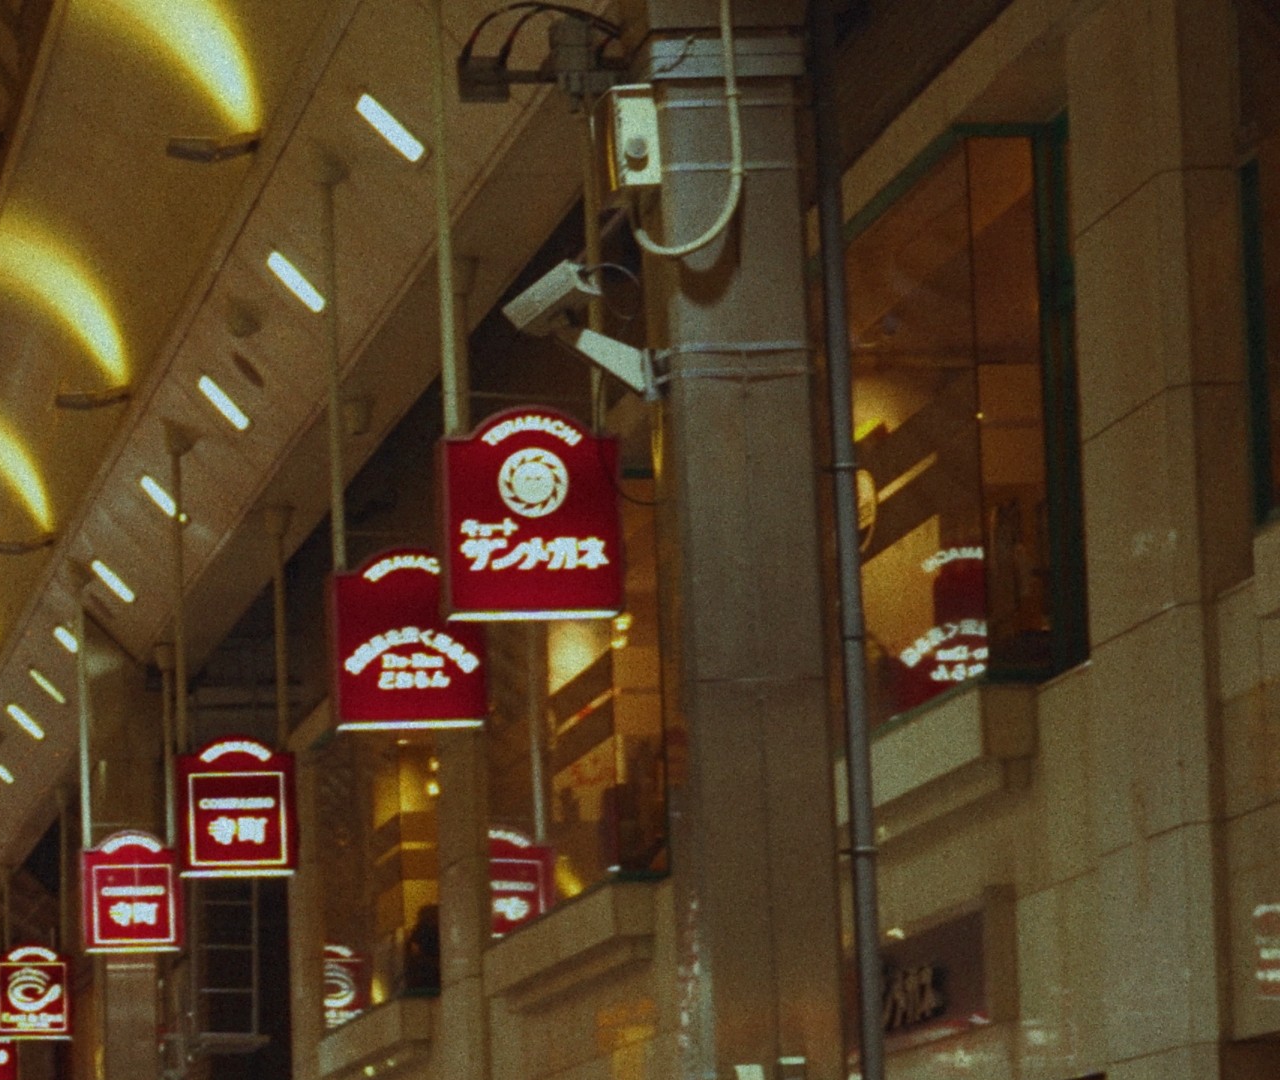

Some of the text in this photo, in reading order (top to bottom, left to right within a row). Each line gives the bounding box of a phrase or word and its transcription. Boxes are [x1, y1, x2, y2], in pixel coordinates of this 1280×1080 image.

[481, 415, 582, 446] TERAMACHI
[363, 555, 440, 582] TERAMAC
[460, 537, 610, 571] サンメガネ
